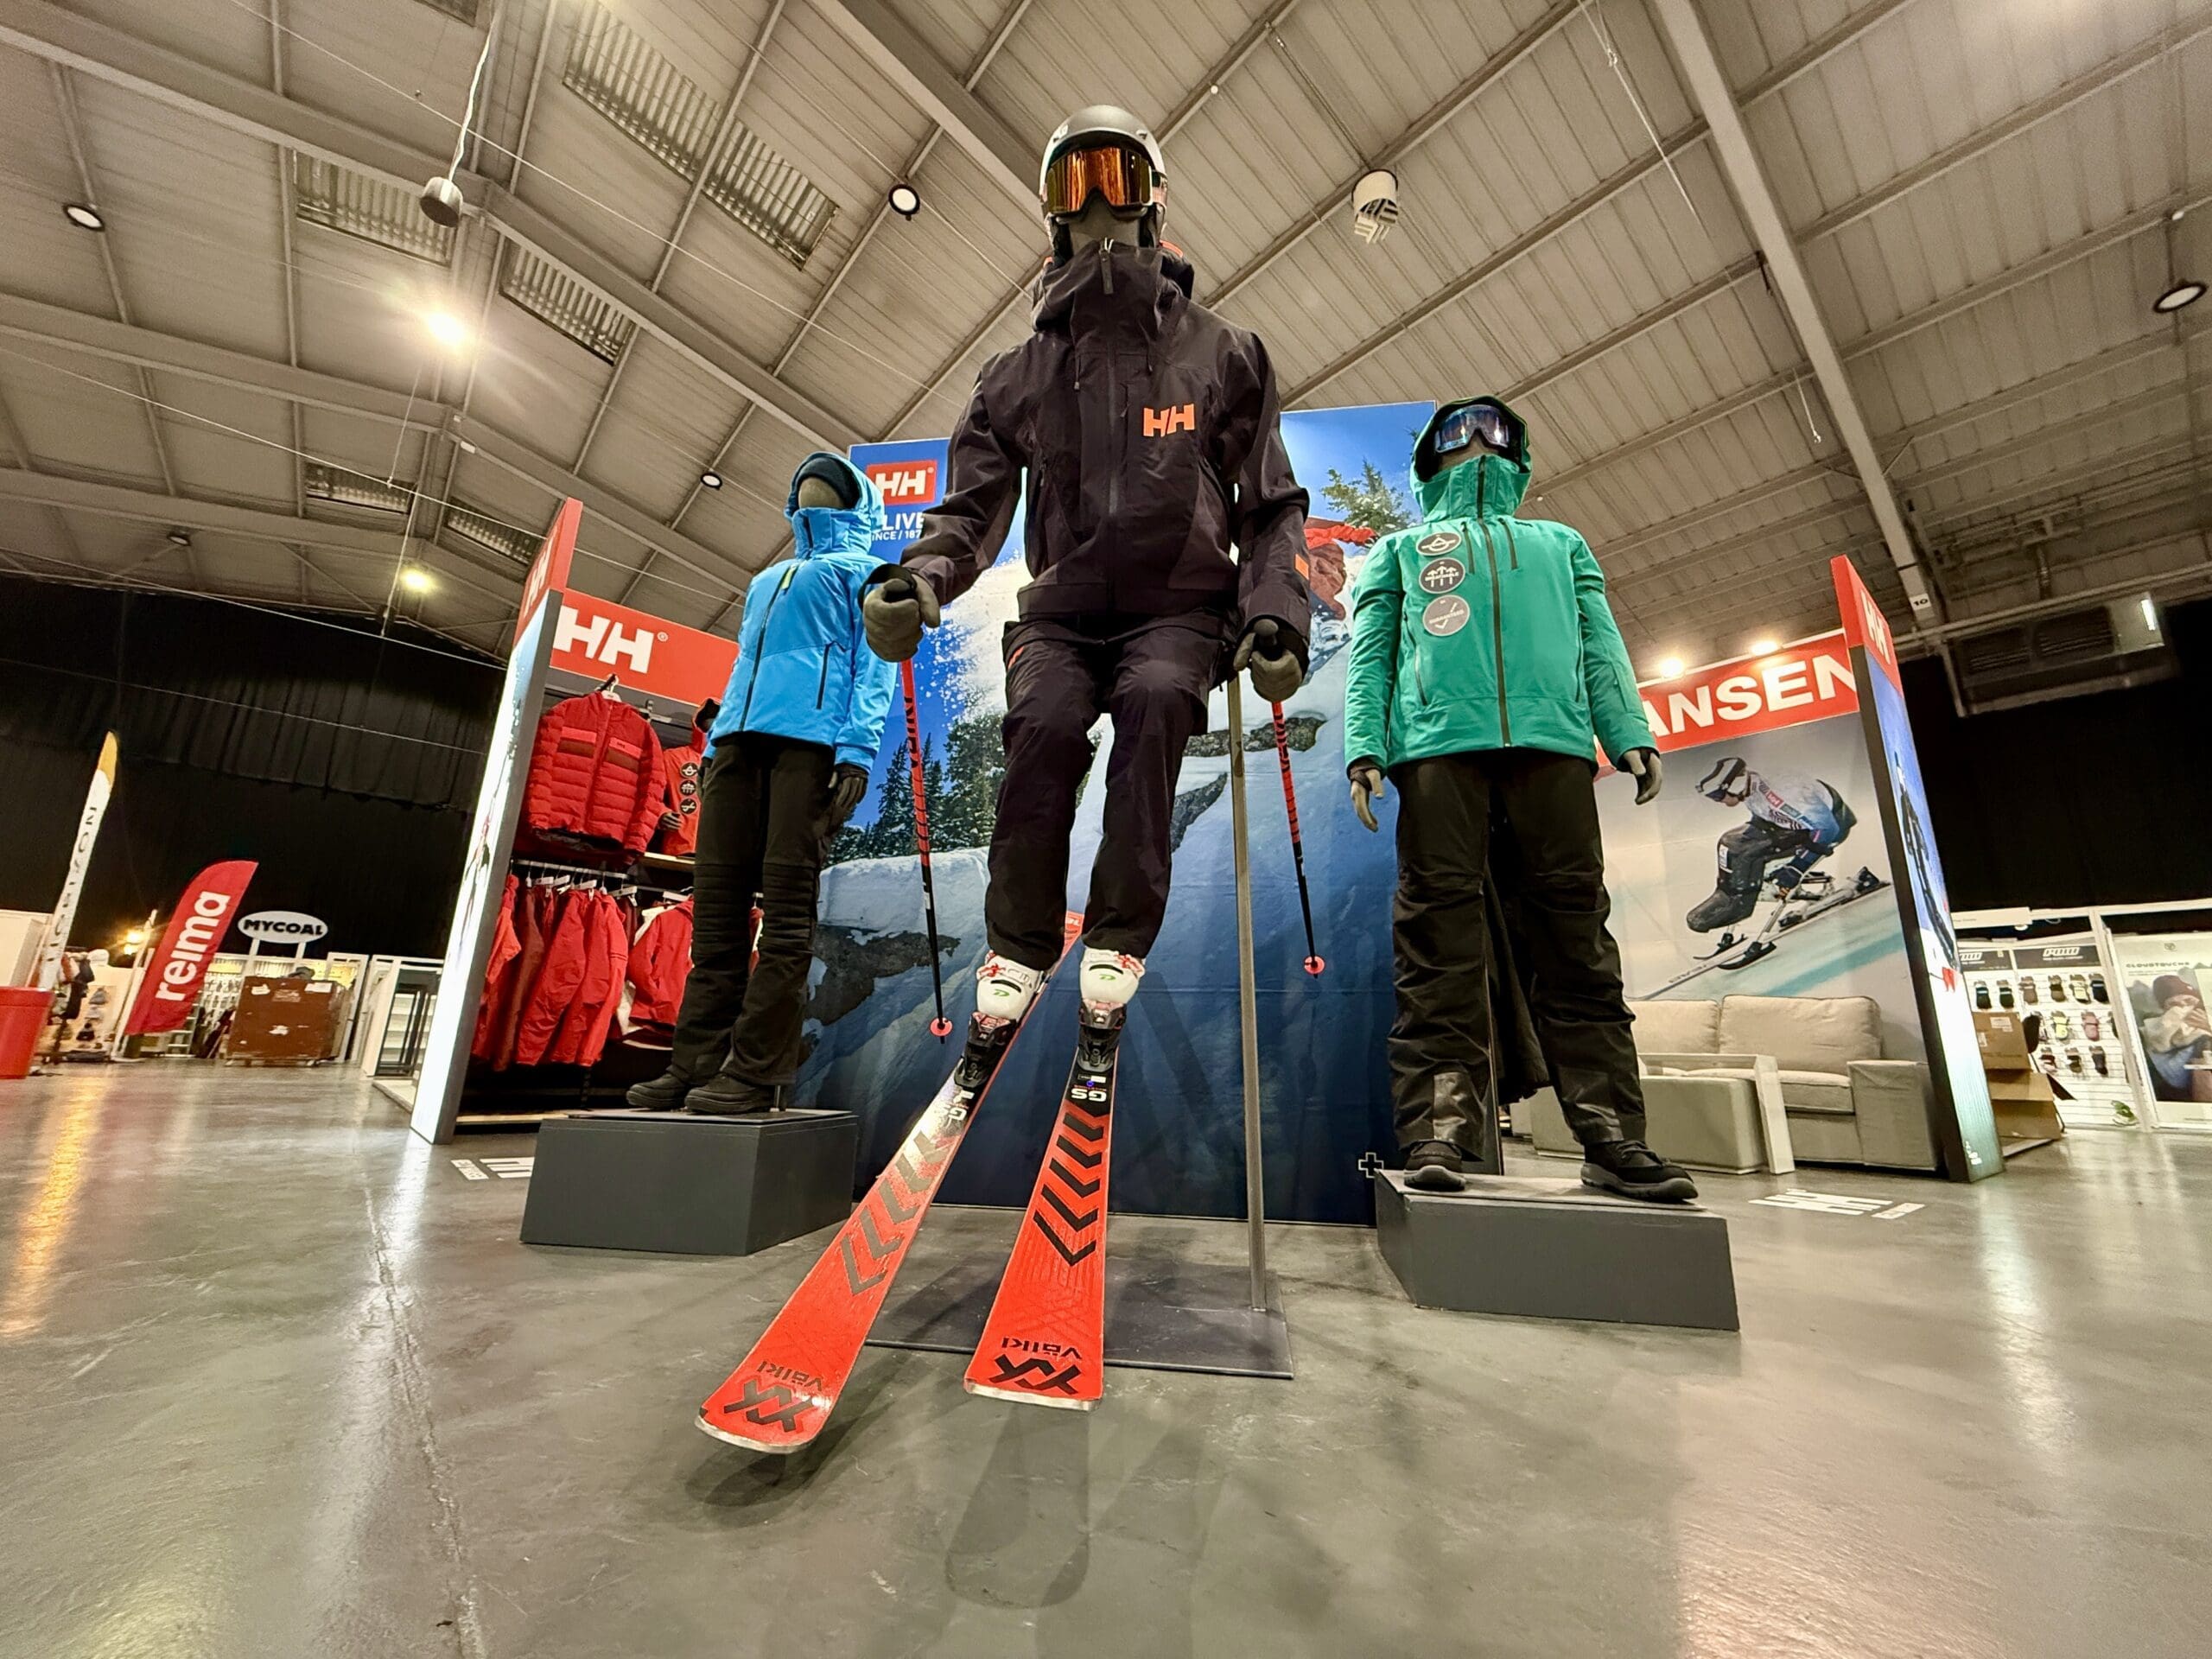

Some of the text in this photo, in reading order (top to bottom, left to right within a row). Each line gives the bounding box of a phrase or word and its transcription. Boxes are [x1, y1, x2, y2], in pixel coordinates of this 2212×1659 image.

[1143, 404, 1195, 437] HH
[874, 469, 926, 498] HH
[1913, 598, 1929, 607] 10
[552, 605, 654, 674] HH
[243, 918, 324, 937] MYCOAL
[156, 891, 231, 1001] reima
[1071, 1088, 1107, 1103] GS
[1001, 1337, 1083, 1360] Völkl
[756, 1359, 824, 1392] Völkl
